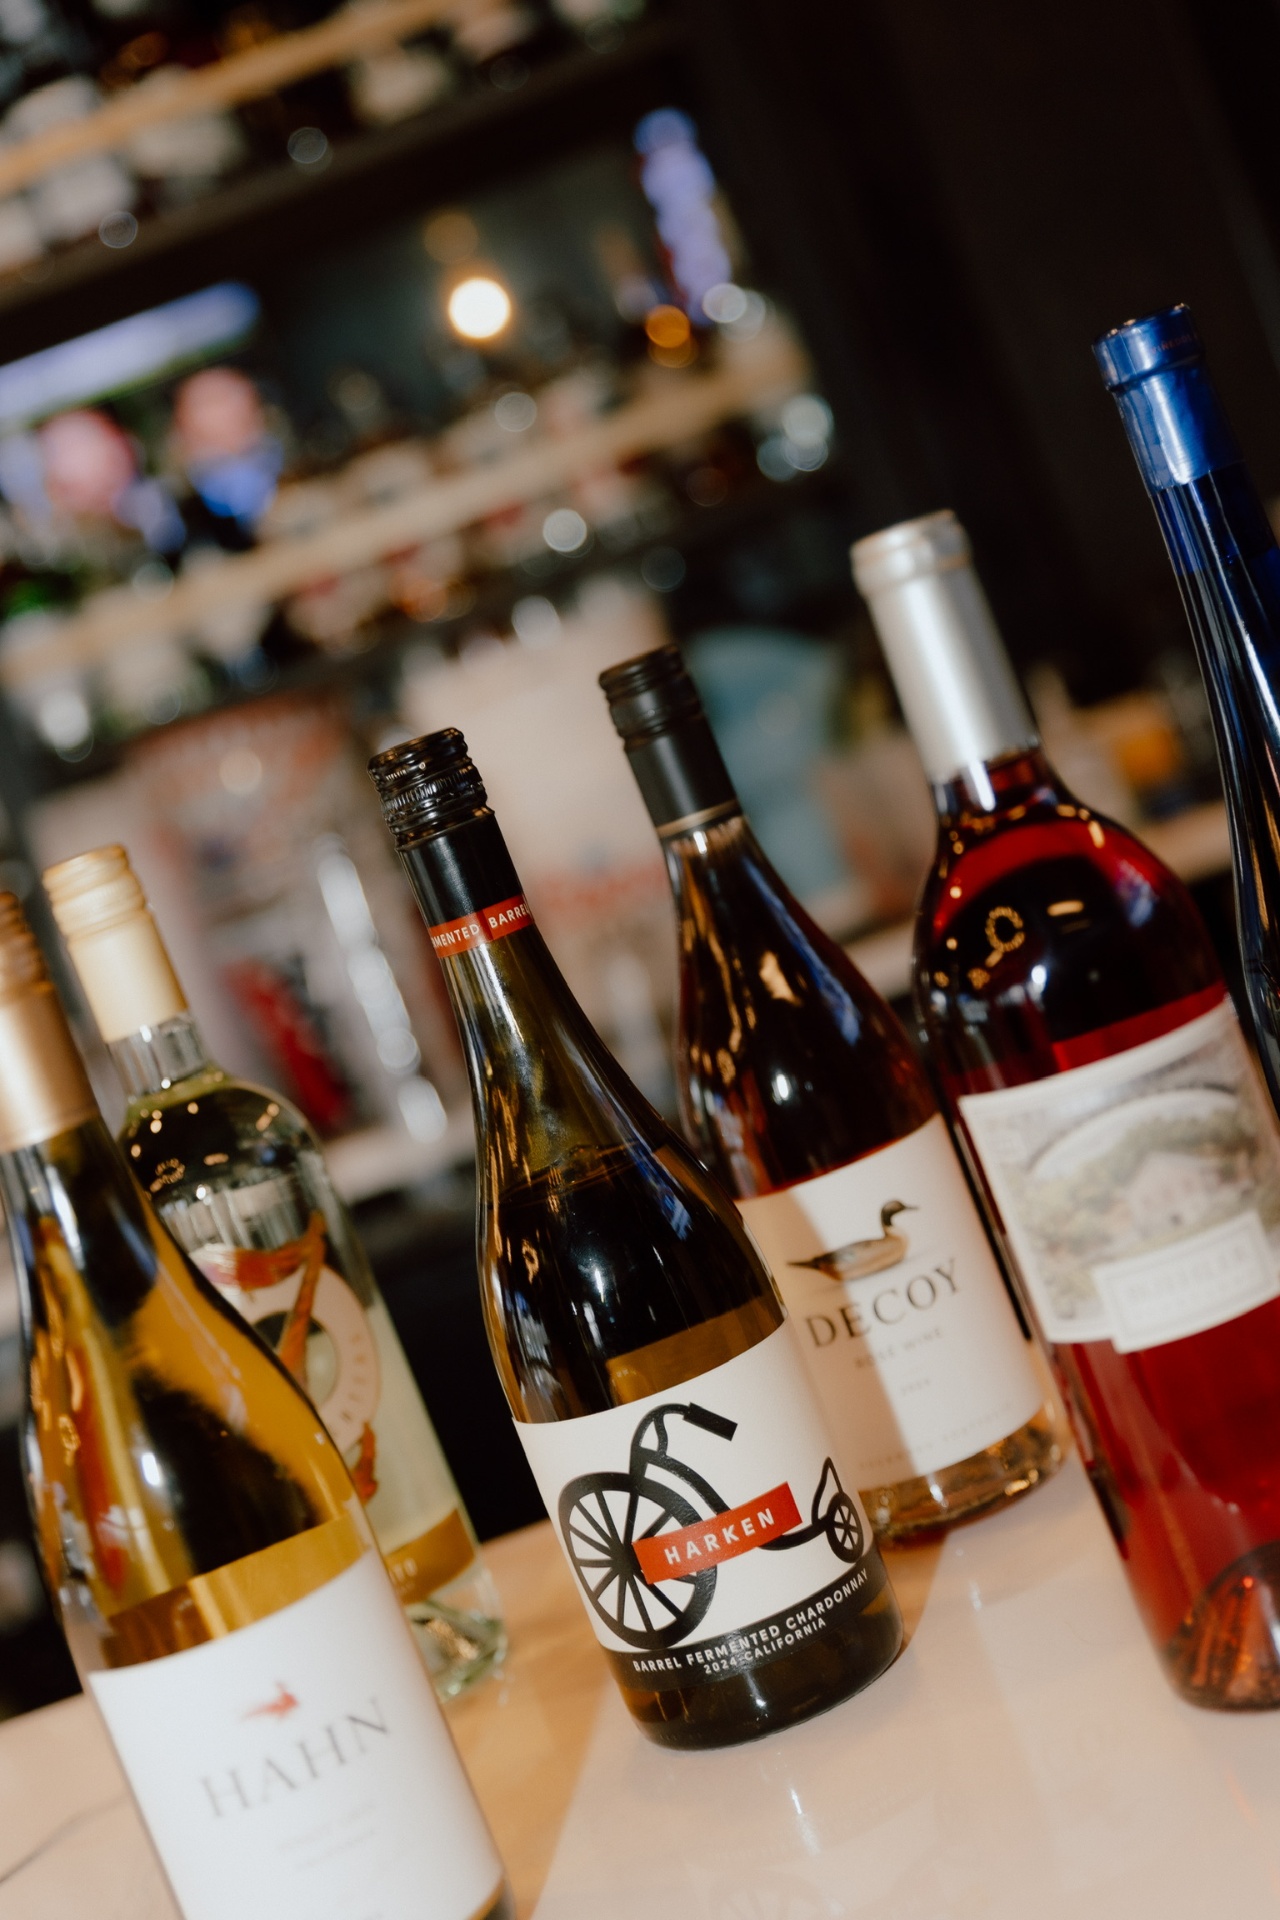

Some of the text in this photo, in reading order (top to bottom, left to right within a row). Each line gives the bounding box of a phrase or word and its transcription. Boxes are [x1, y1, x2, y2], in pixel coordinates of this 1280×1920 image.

[805, 1257, 961, 1348] DECOY
[664, 1507, 775, 1566] HARKEN
[633, 1567, 868, 1673] BARREL FERMENTED CHARDONNAY
[704, 1617, 827, 1675] 2024 CALIFORNIA
[199, 1697, 390, 1818] HAHN
